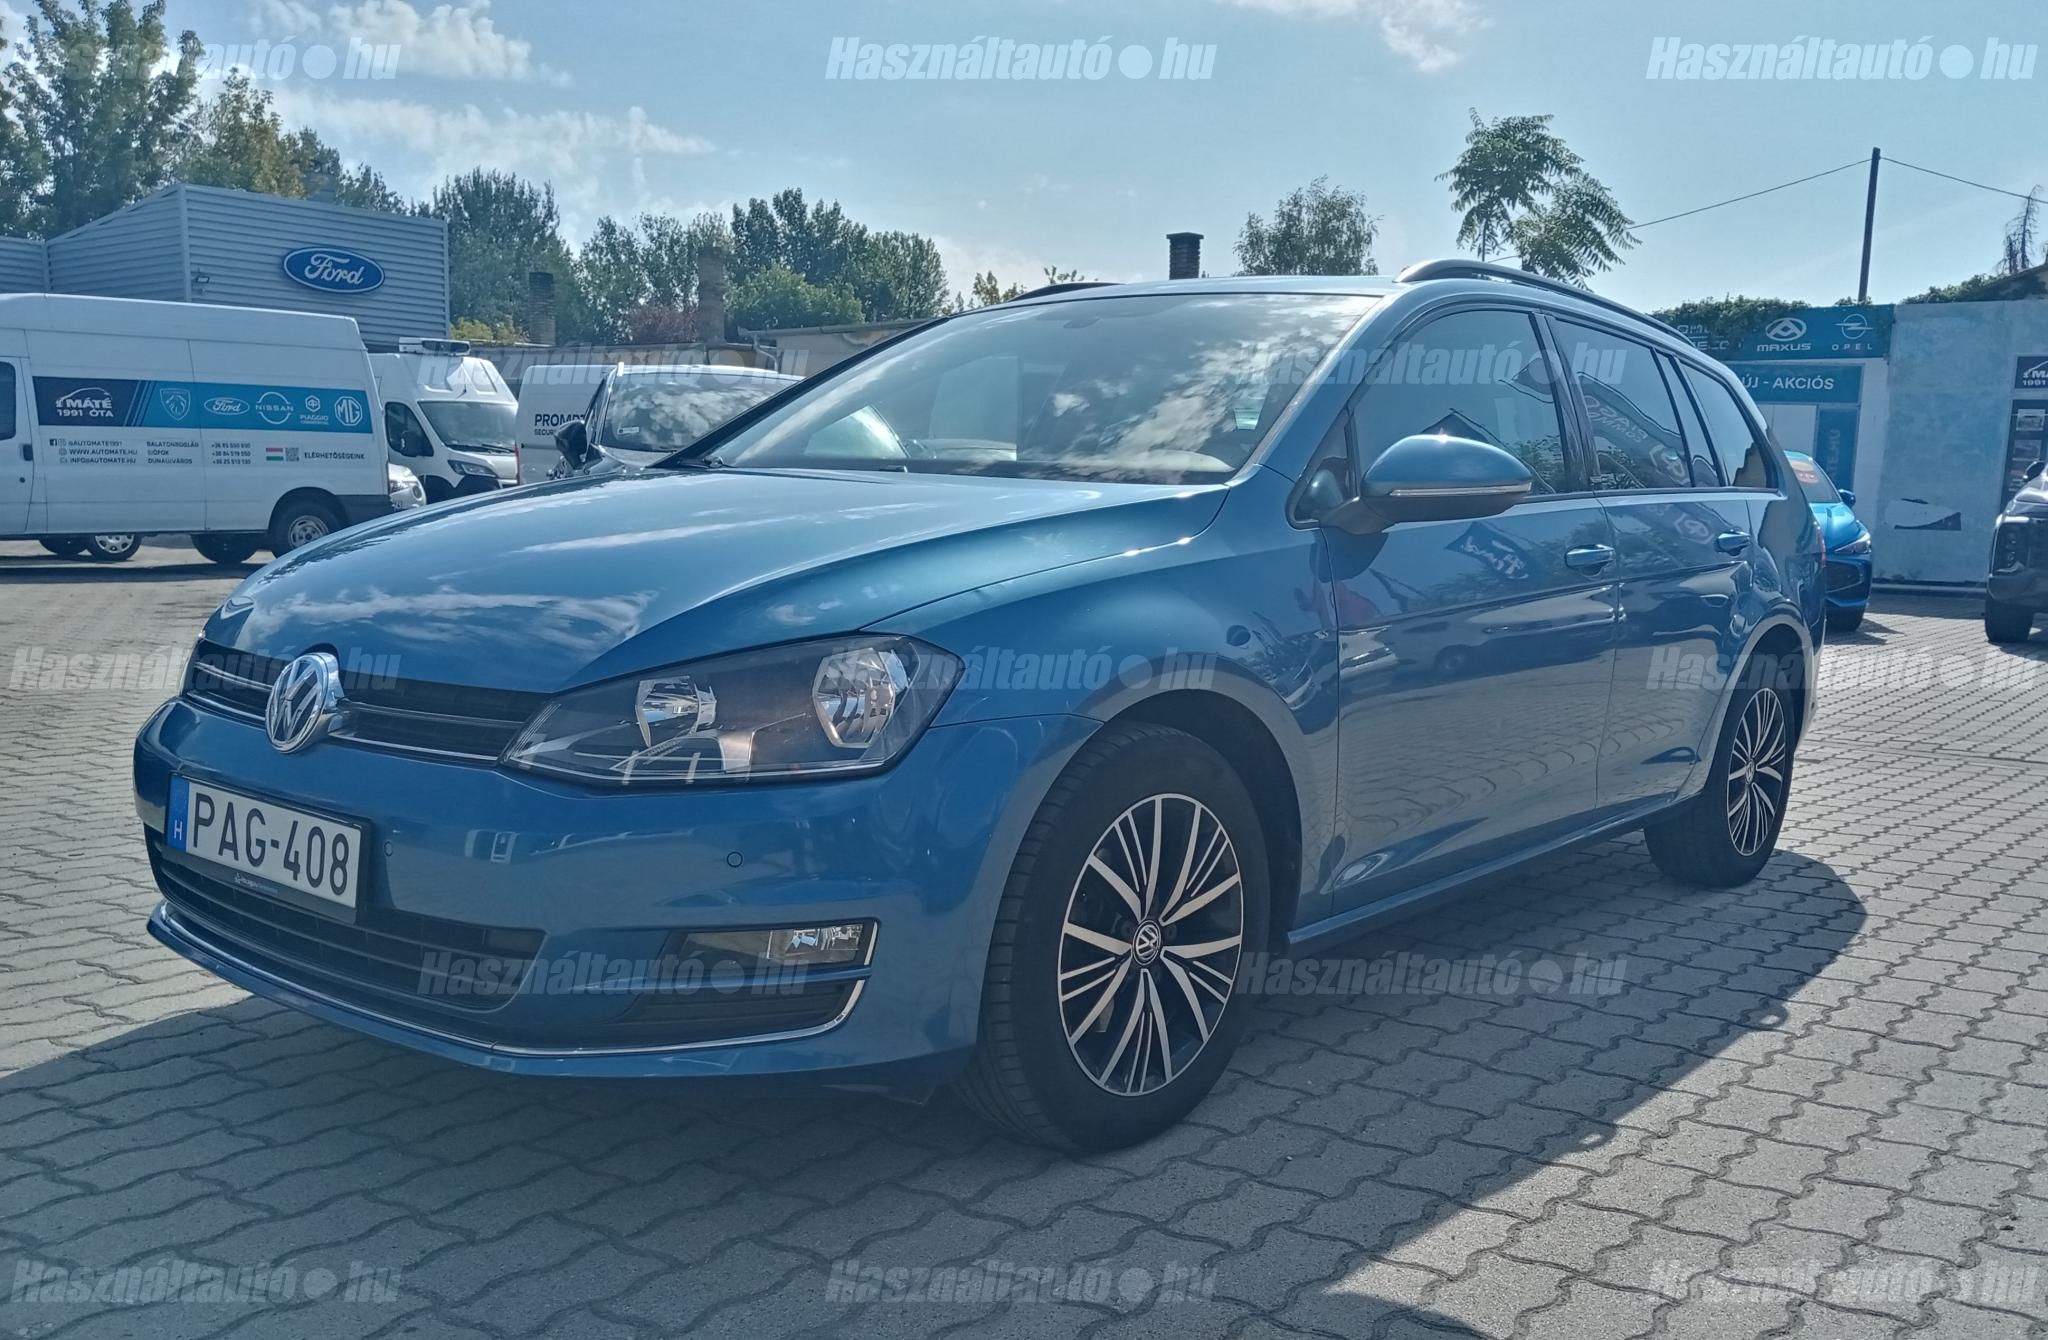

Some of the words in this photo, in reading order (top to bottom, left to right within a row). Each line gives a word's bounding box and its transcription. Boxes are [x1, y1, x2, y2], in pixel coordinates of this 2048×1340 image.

[305, 253, 364, 284] Ford
[1756, 343, 1812, 352] MAXUS
[1831, 343, 1873, 351] OPEL
[1772, 375, 1835, 390] AKCIÓS
[66, 397, 113, 409] MÁTÉ
[212, 400, 241, 412] Ford
[256, 404, 294, 412] NISSAN
[57, 409, 83, 417] 1991
[89, 409, 114, 418] ÓTA
[173, 820, 183, 841] H
[193, 791, 350, 896] PAG-408
